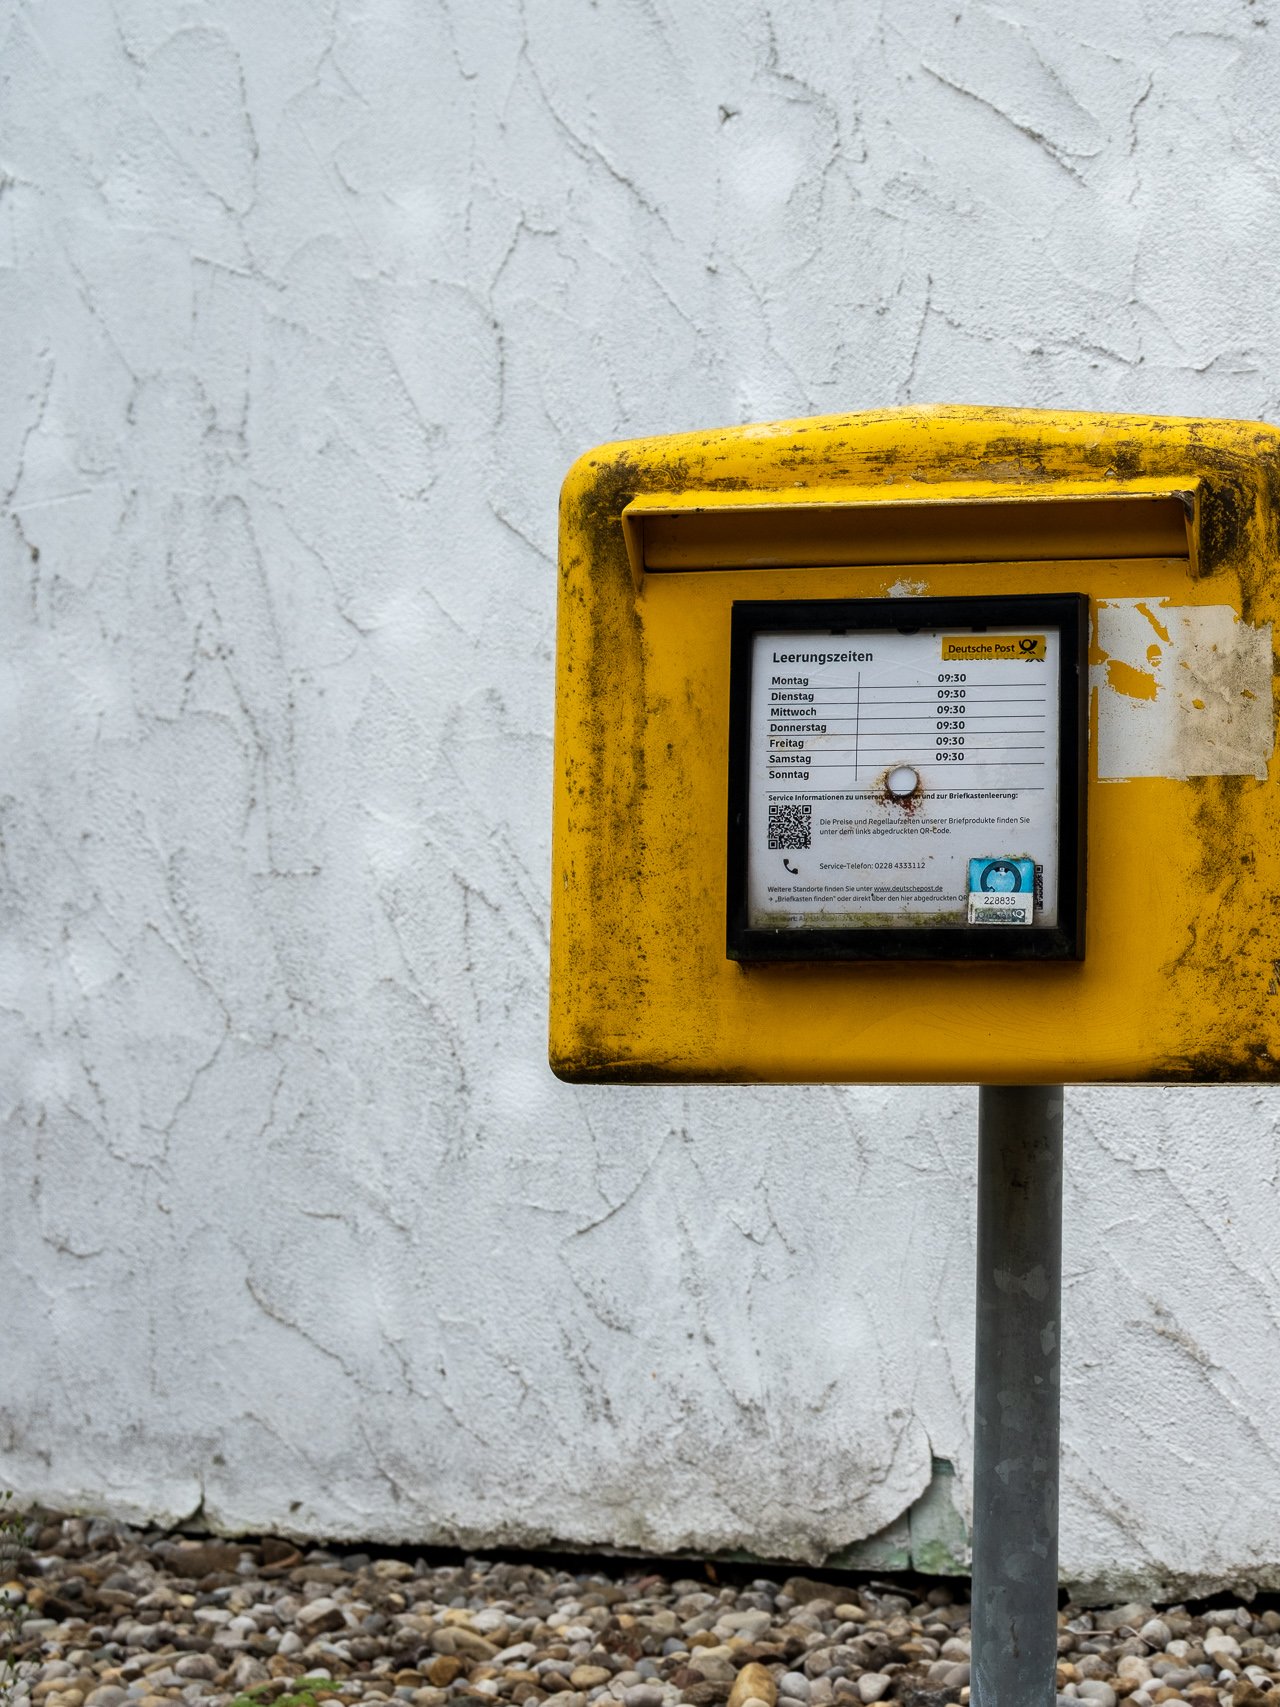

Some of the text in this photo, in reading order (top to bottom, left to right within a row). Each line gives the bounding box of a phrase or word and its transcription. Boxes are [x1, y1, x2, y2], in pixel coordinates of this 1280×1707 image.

[948, 644, 1015, 653] Deutsche Post
[773, 651, 873, 664] Leerungszeiten
[772, 674, 966, 686] Montag 09:30
[771, 690, 966, 702] Dienstag 09:30
[771, 705, 966, 716] Mittwoch 09:30
[770, 721, 965, 733] Donnerstag 09:30
[769, 737, 965, 749] Freitag 09:30
[769, 753, 964, 765] Samstag 09:30
[769, 770, 809, 780] Sonntag
[949, 792, 1018, 800] Briefkastenleerung:
[984, 896, 1016, 905] 228835
